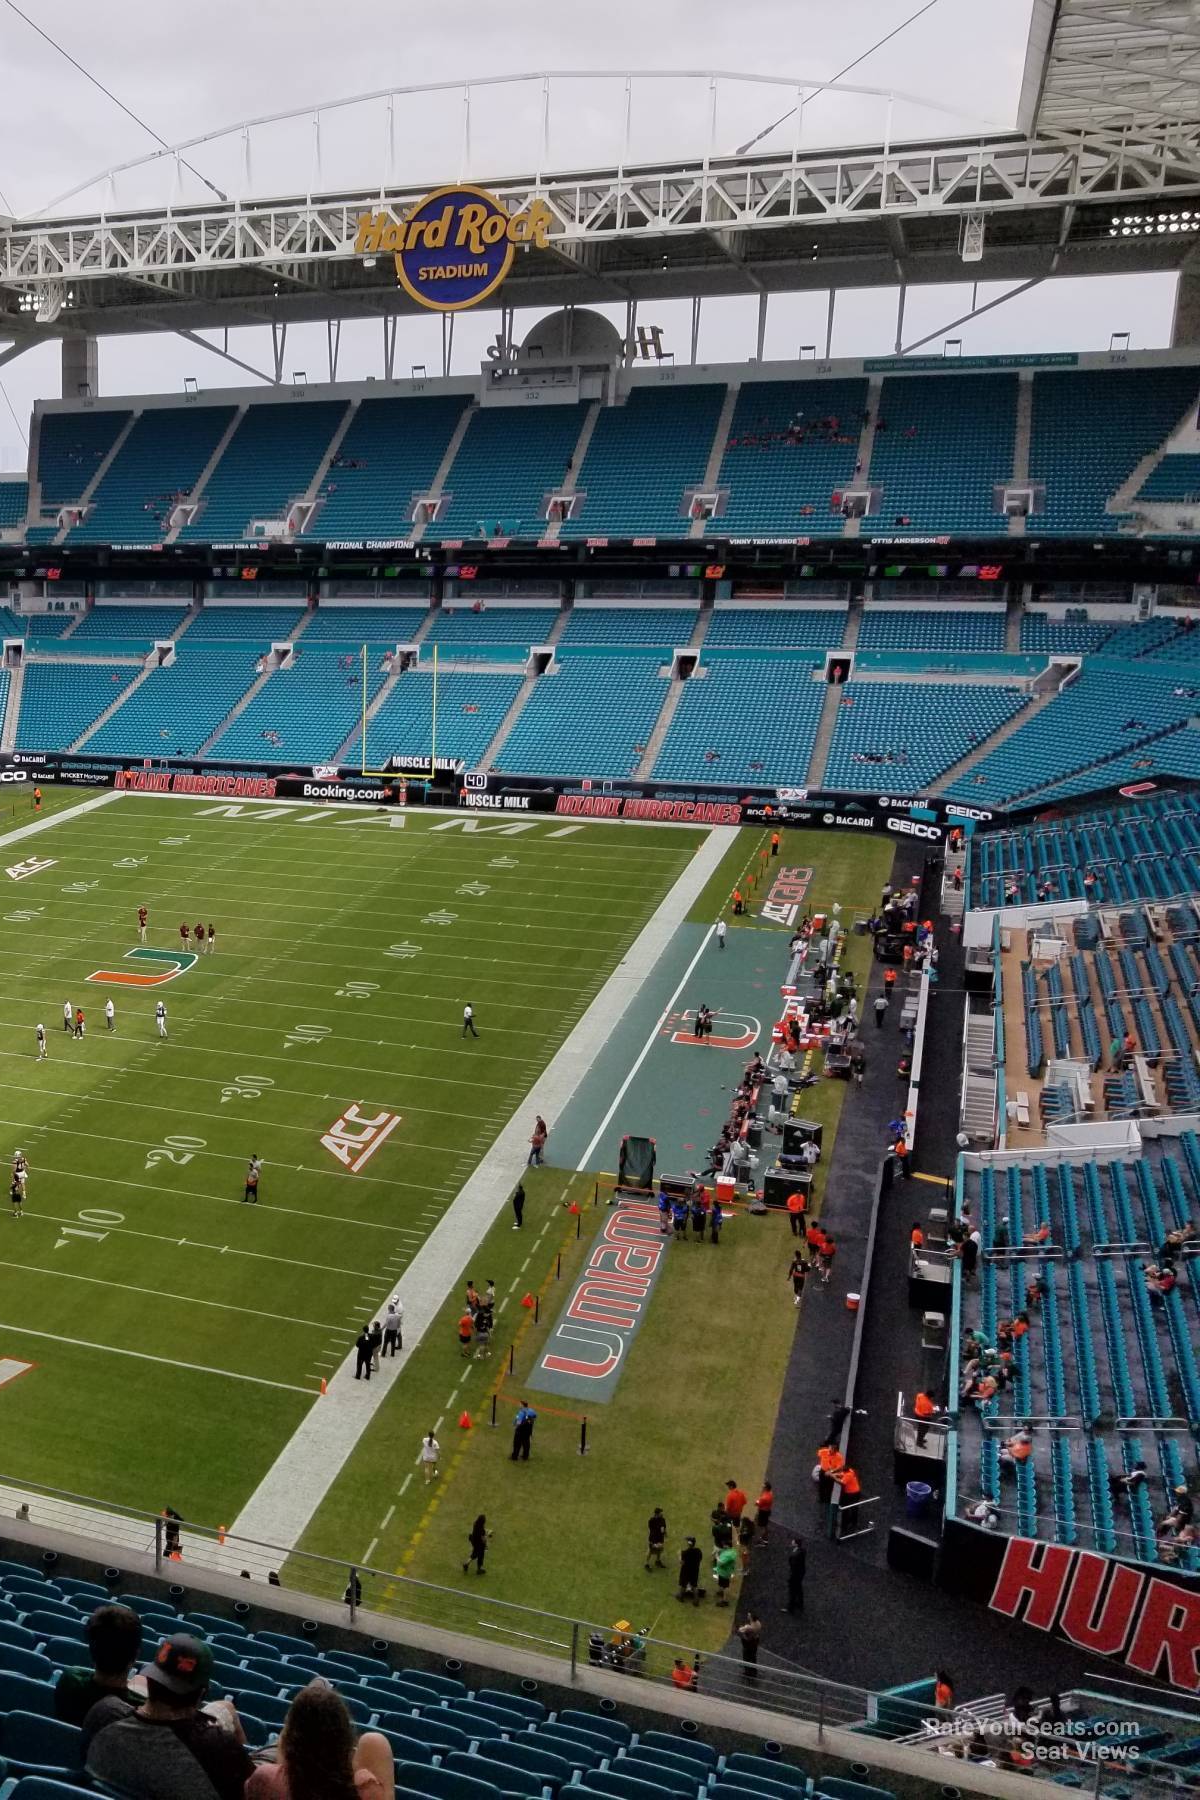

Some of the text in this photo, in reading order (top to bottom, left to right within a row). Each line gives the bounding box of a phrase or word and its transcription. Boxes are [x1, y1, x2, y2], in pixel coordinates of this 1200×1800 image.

[355, 198, 553, 254] Hard Rock
[418, 262, 489, 281] STADIUM
[325, 540, 415, 550] NATIONAL CHAMPIONS
[392, 755, 457, 770] MUSCLE MILK
[60, 771, 84, 780] ROCKET
[84, 773, 109, 782] Mortgage
[114, 770, 277, 798] MIAMI HURRICANES
[303, 783, 385, 801] Booking.com
[503, 796, 530, 809] MILK
[890, 797, 929, 810] BACARDÍ
[556, 795, 622, 816] MIAMI
[622, 798, 742, 824] HURRICANES
[835, 814, 874, 828] BACARDÍ
[945, 804, 992, 820] GEICO
[193, 804, 588, 840] MIAMI
[887, 818, 941, 841] GEICO
[5, 857, 57, 881] ACC
[85, 948, 199, 987] U
[335, 980, 381, 1000] 50
[286, 1024, 333, 1045] 40
[670, 1009, 762, 1050] U
[221, 1074, 275, 1100] 30
[320, 1103, 398, 1171] ACC
[146, 1135, 208, 1165] 20
[60, 1208, 126, 1243] 10
[541, 1323, 624, 1378] U
